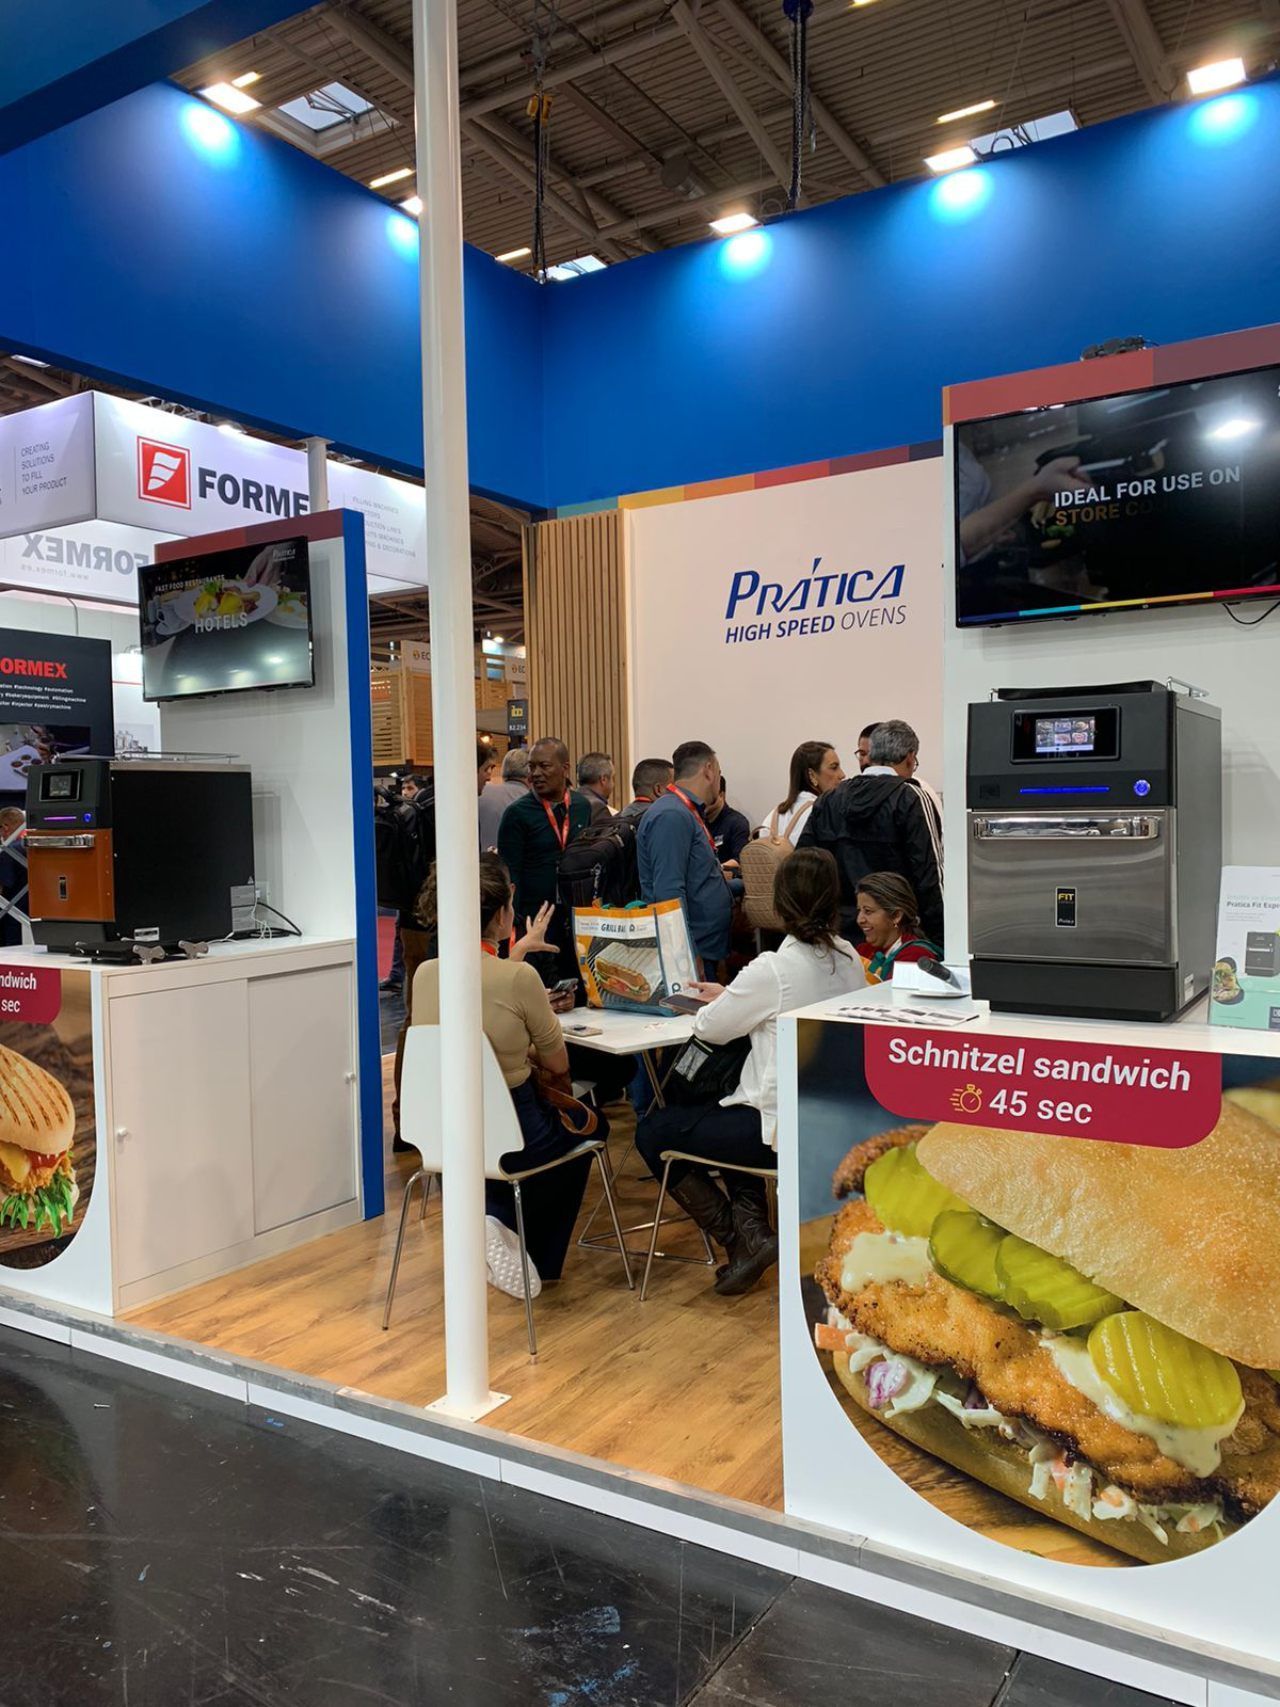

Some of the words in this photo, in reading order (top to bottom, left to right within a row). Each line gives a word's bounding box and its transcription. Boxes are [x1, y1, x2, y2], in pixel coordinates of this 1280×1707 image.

[21, 442, 50, 457] CREATING
[22, 453, 55, 470] SOLUTIONS
[22, 473, 30, 482] TO
[31, 471, 42, 480] FILL
[22, 484, 38, 495] YOUR
[39, 476, 67, 490] PRODUCT
[1054, 486, 1110, 507] IDEAL
[1116, 478, 1156, 499] FOR
[1162, 472, 1203, 492] USE
[1209, 466, 1241, 485] ON
[198, 467, 310, 518] FORME
[1055, 503, 1120, 526] STORE
[155, 584, 168, 592] FAST
[169, 582, 184, 591] FOOD
[185, 574, 225, 589] RESTAURANTS
[195, 612, 248, 634] HOTELS
[726, 623, 771, 643] HIGH
[776, 615, 835, 638] SPEED
[841, 605, 907, 630] OVENS
[0, 657, 67, 679] ORMEX
[1058, 893, 1075, 901] FIT
[601, 923, 617, 933] GRILL
[1, 999, 21, 1013] sec
[888, 1038, 1025, 1076] Schnitzel
[1033, 1058, 1191, 1092] sandwich
[989, 1089, 1028, 1115] 45
[1037, 1099, 1092, 1125] sec
